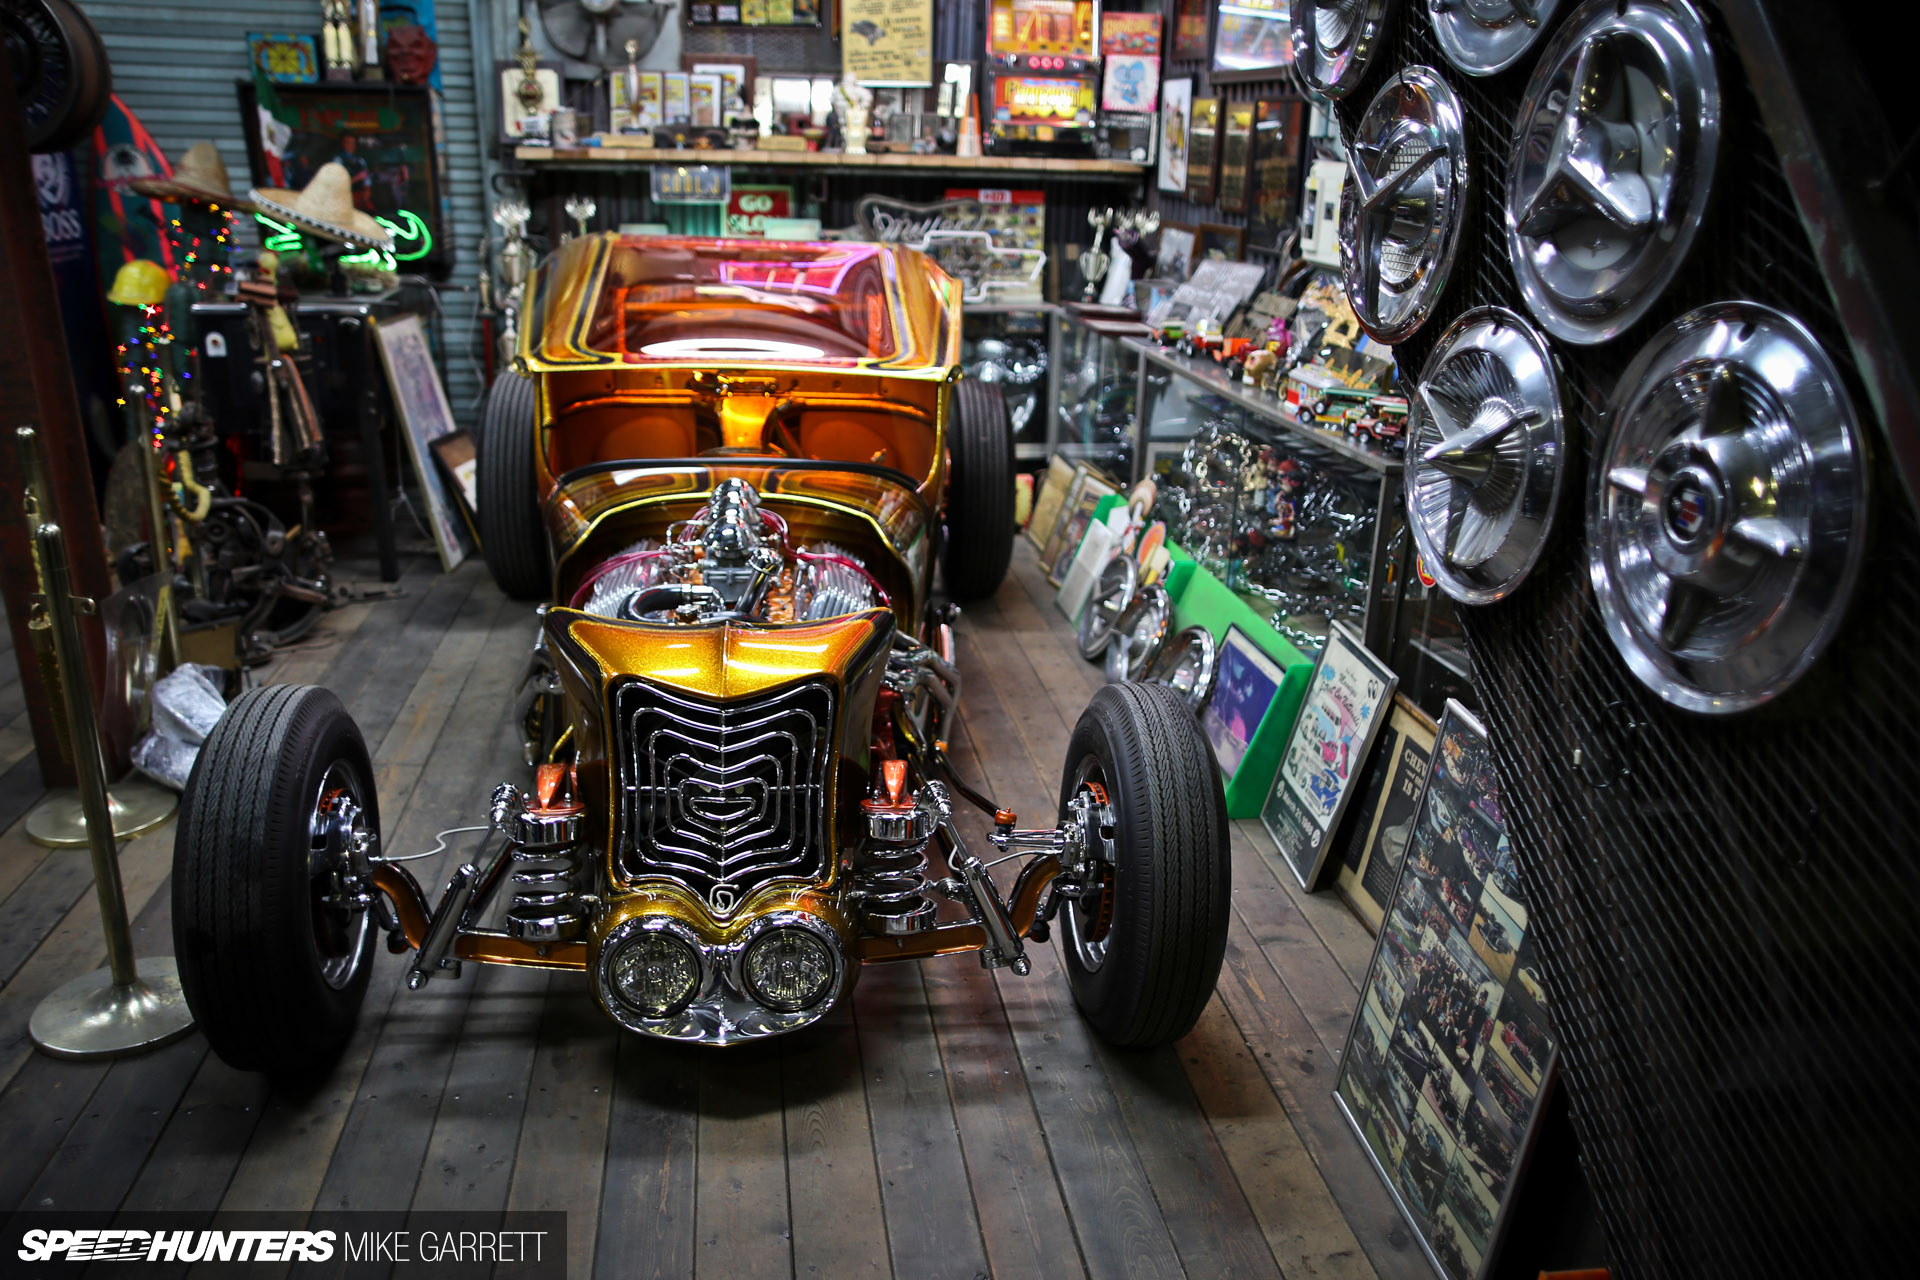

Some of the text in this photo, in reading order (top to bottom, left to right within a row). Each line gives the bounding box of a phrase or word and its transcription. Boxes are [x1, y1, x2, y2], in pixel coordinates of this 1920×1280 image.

[738, 195, 773, 213] GO
[728, 213, 767, 233] SLO
[1404, 748, 1428, 777] CHEV
[1283, 791, 1296, 813] March
